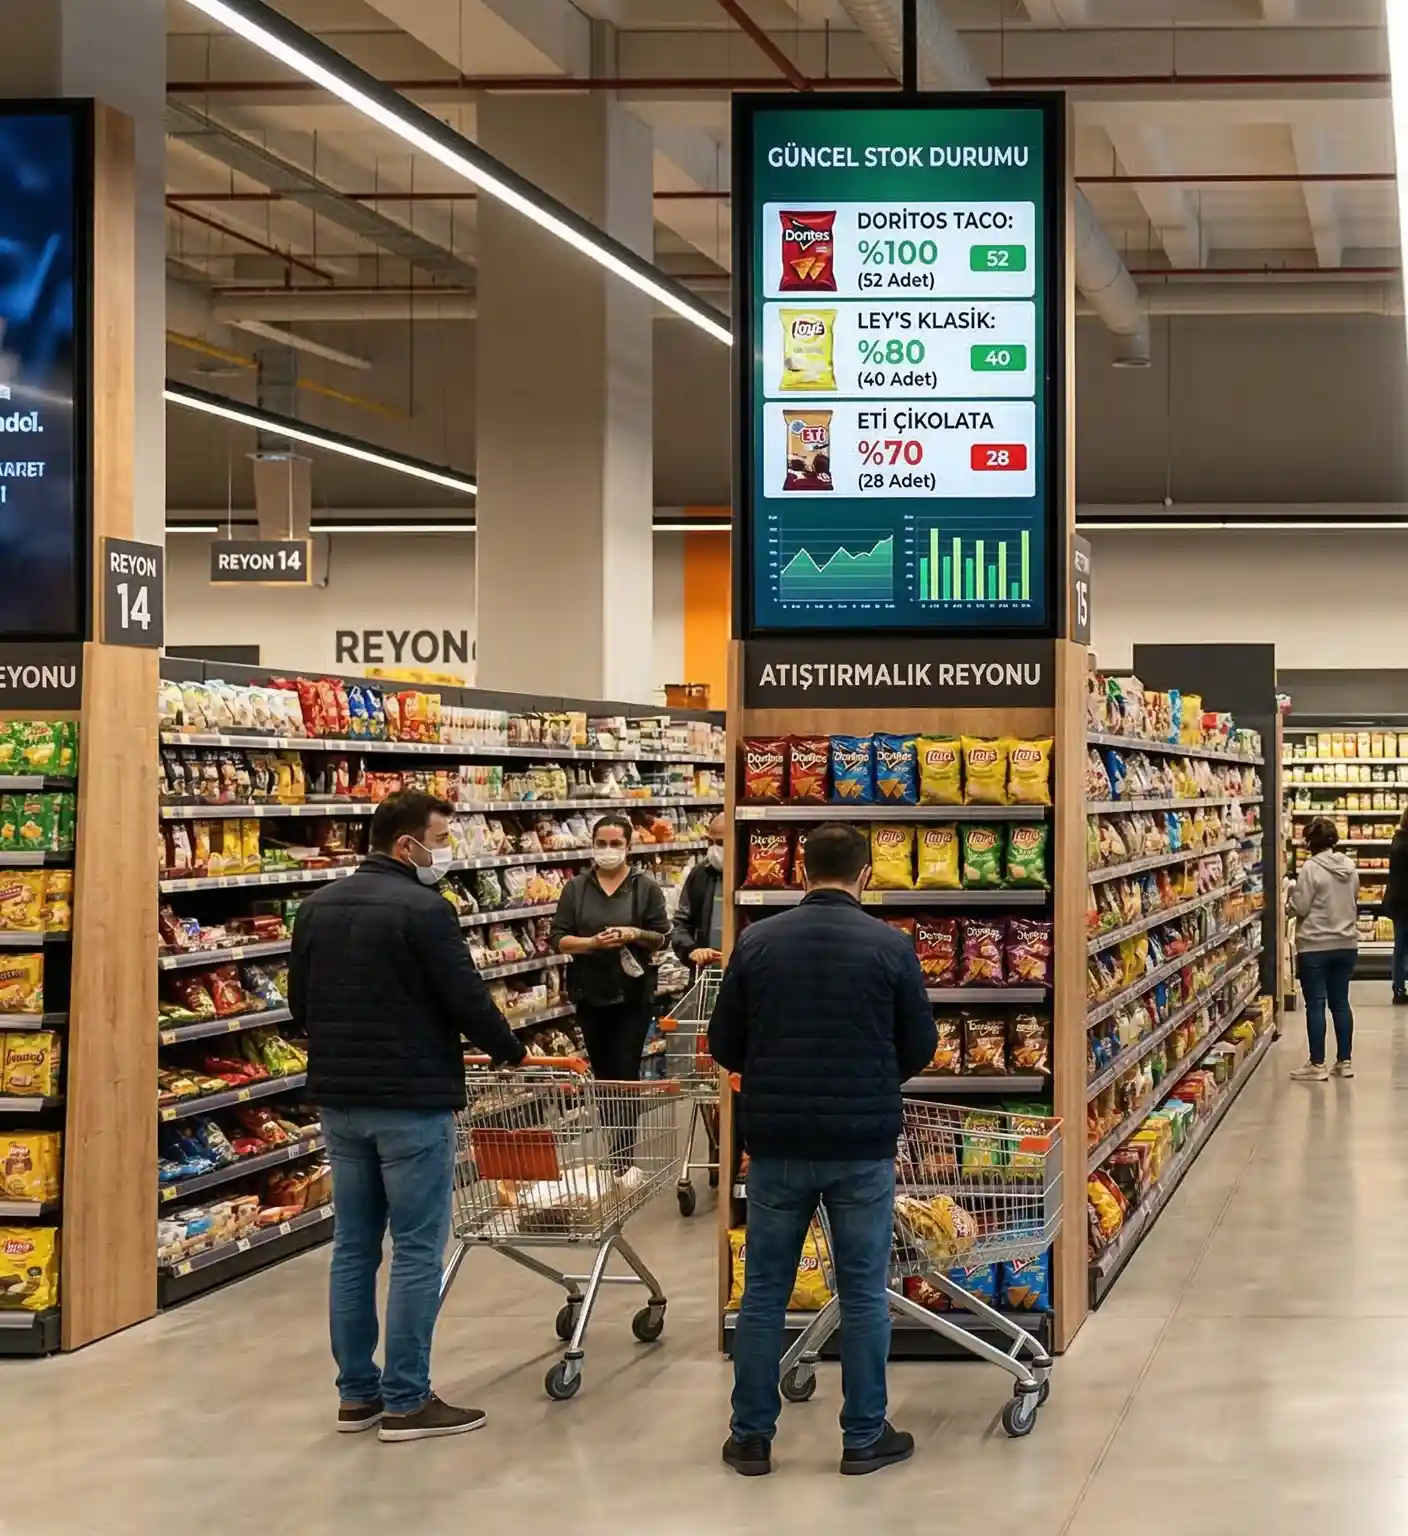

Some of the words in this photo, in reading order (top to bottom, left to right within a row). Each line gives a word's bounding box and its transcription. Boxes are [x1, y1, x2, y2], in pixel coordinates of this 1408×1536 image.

[768, 142, 859, 168] GÜNCEL
[864, 146, 924, 168] STOK
[930, 146, 1030, 168] DURUMU
[857, 207, 948, 231] DORİTOS
[953, 211, 1014, 231] TACO:
[858, 239, 939, 266] %100
[986, 250, 1010, 269] 52
[857, 272, 884, 291] (52
[887, 272, 936, 291] Adet)
[857, 311, 912, 331] LEY'S
[918, 306, 997, 331] KLASİK:
[858, 339, 926, 366] %80
[984, 349, 1011, 367] 40
[857, 371, 887, 390] (40
[890, 371, 939, 390] Adet)
[857, 408, 888, 431] ETİ
[893, 408, 995, 434] ÇİKOLATA
[858, 440, 925, 467] %70
[986, 449, 1011, 468] 28
[857, 474, 885, 492] (28
[888, 474, 937, 492] Adet)
[110, 551, 157, 577] REYON
[218, 553, 274, 571] REYON
[277, 550, 302, 571] 14
[116, 582, 152, 631] 14
[335, 629, 476, 664] REYON
[758, 663, 932, 691] ATIŞTIRMALIK
[938, 663, 1042, 687] REYONU
